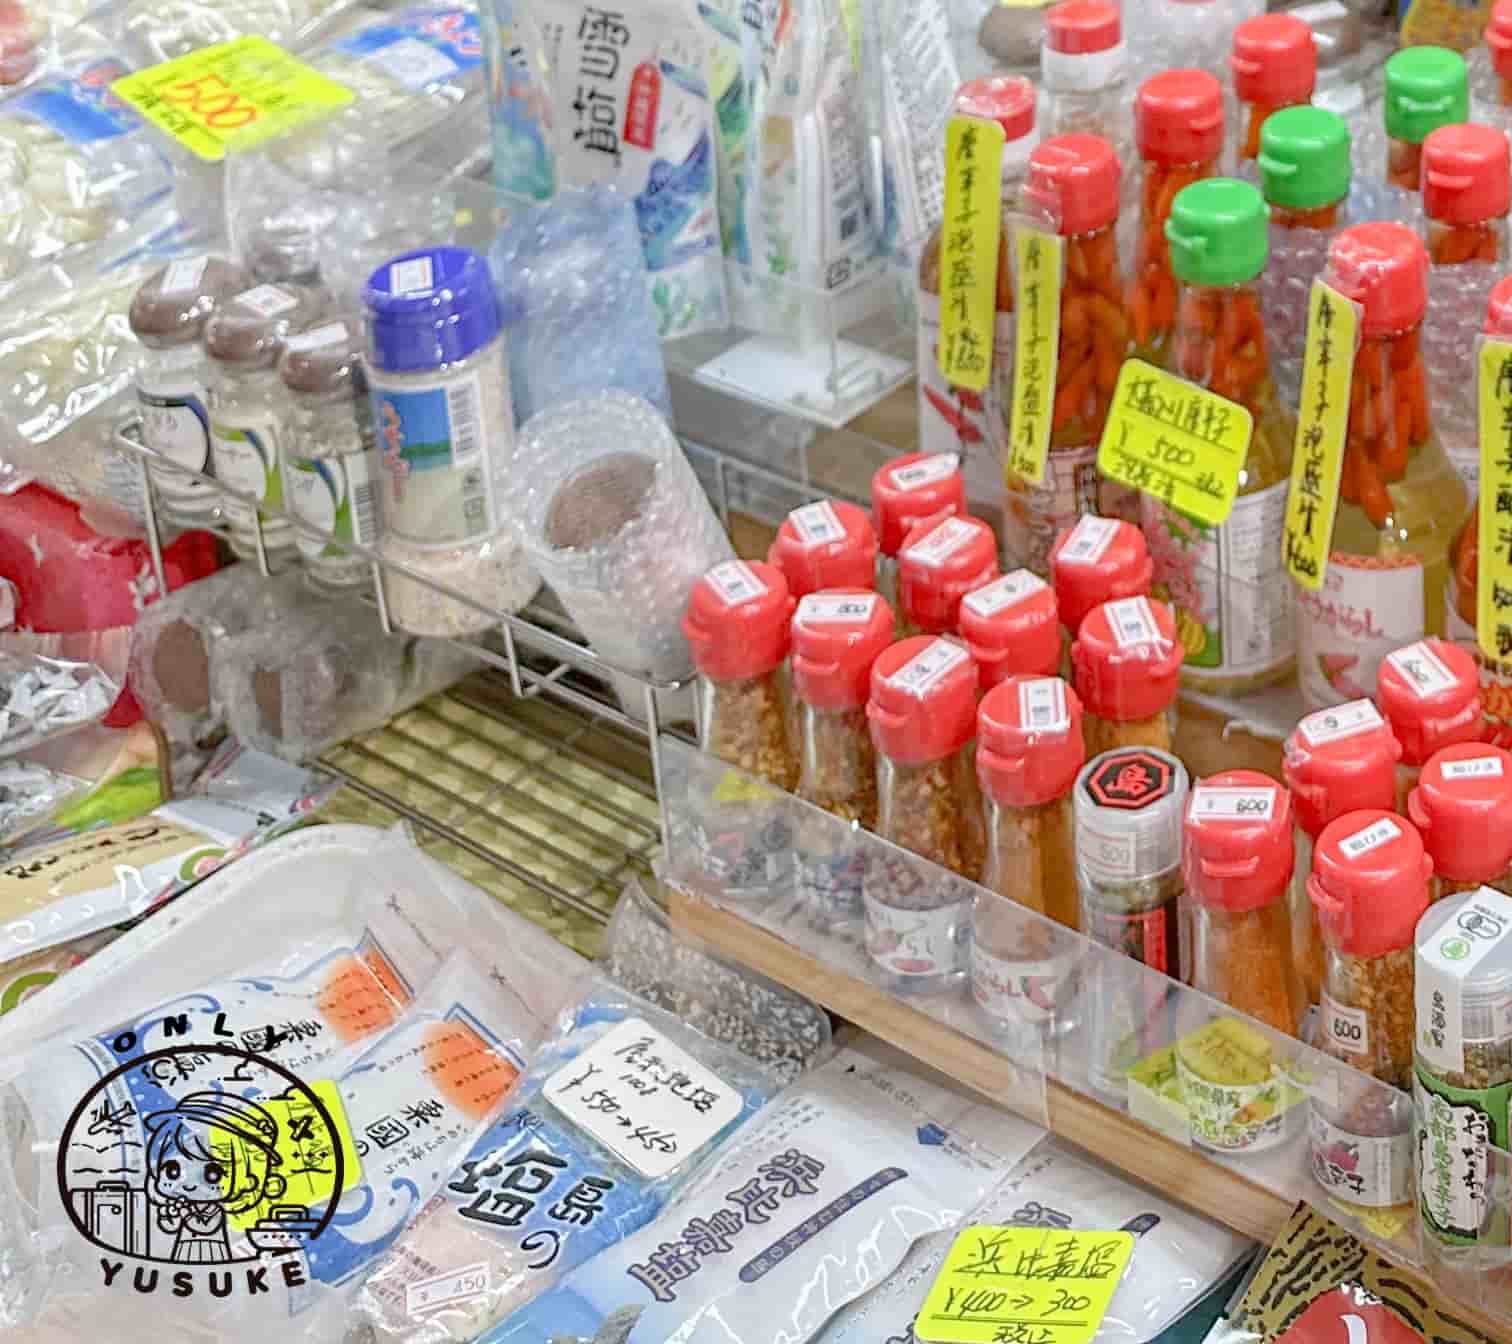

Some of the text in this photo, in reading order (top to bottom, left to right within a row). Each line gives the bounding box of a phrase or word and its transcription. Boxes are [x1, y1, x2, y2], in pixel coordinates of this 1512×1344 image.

[1147, 437, 1195, 467] 500
[1235, 797, 1270, 816] 600
[1332, 1017, 1363, 1044] 600
[556, 1062, 604, 1094] ¥
[943, 1287, 1093, 1316] ¥ 400 300
